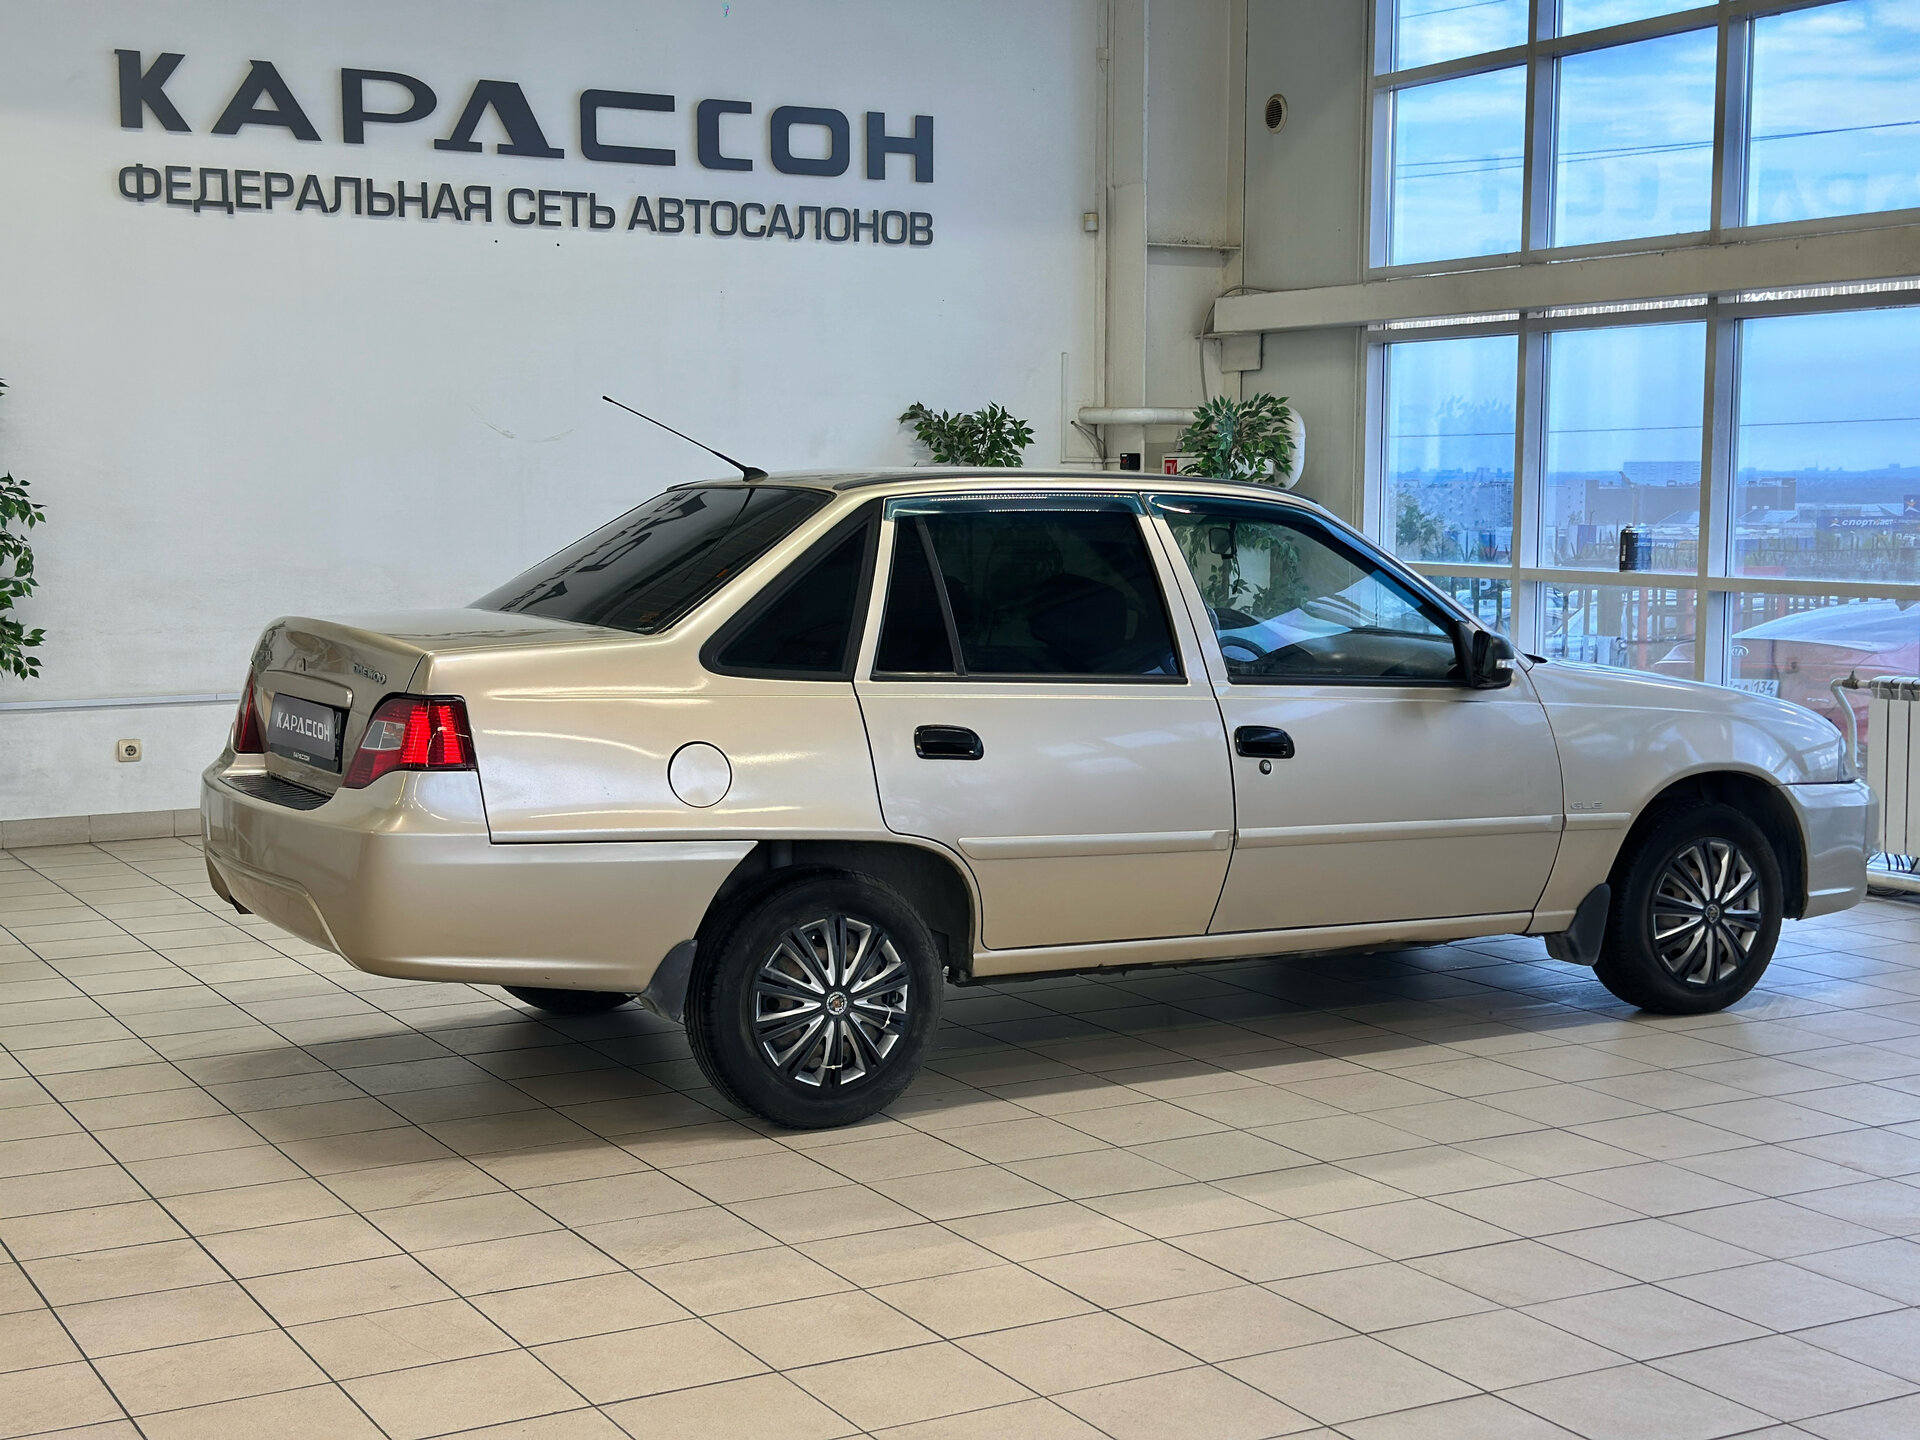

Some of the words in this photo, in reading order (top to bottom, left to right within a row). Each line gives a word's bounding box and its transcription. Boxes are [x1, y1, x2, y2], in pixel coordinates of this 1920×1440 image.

[118, 163, 492, 223] ФЕДЕРАЛЬНАЯ
[507, 188, 616, 229] СЕТЬ
[627, 195, 934, 246] АВТОСАЛОНОВ
